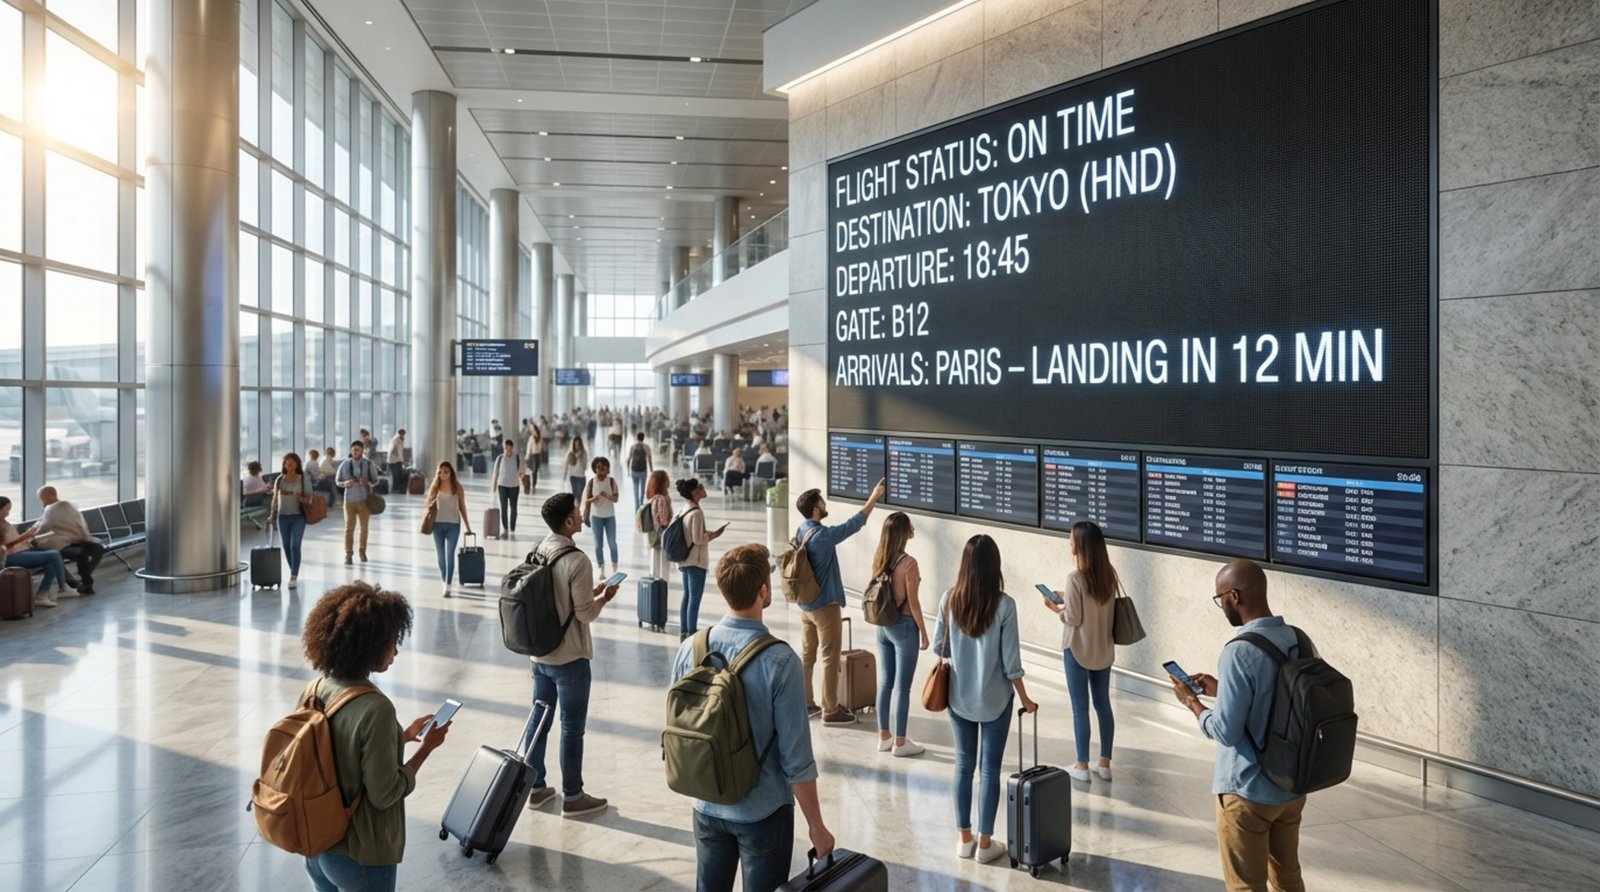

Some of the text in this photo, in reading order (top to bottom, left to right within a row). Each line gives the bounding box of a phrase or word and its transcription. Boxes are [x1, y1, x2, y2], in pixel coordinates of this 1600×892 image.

[836, 89, 1135, 208] FLIGHT STATUS: ON TIME
[836, 142, 1177, 253] DESTINATION: TOKYO (HND)
[836, 234, 1030, 297] DEPARTURE: 18:45
[836, 302, 930, 342] GATE: B12
[835, 350, 929, 386] ARRIVALS:
[935, 347, 1002, 385] PARIS
[1032, 339, 1168, 385] LANDING
[1182, 336, 1217, 384] IN
[1232, 333, 1279, 383] 12
[1295, 328, 1383, 383] MIN
